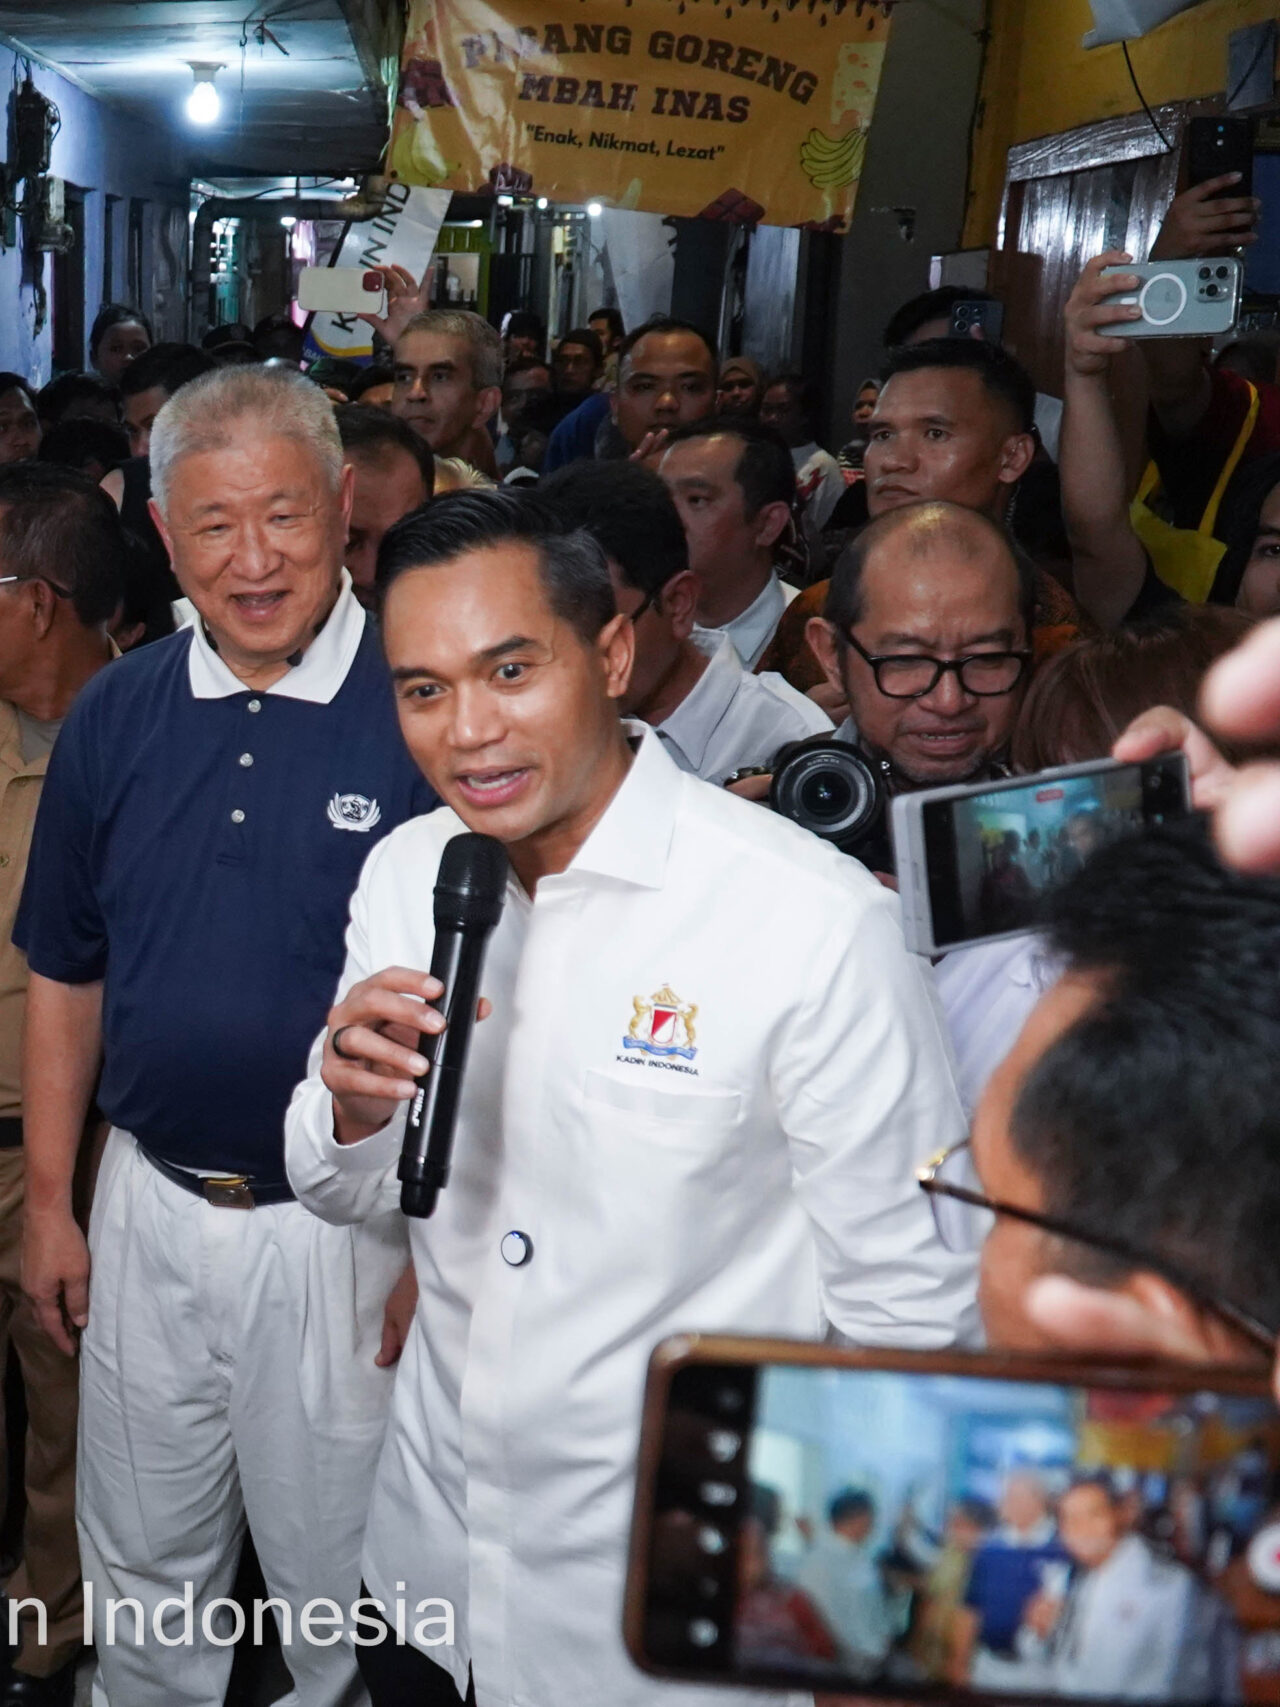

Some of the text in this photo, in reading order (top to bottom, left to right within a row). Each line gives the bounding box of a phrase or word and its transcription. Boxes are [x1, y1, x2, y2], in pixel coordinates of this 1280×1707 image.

[648, 30, 818, 105] GORENG
[519, 72, 751, 123] MBAH INAS
[589, 131, 660, 158] Nikmat,
[616, 1054, 699, 1076] KADIN INDONESIA
